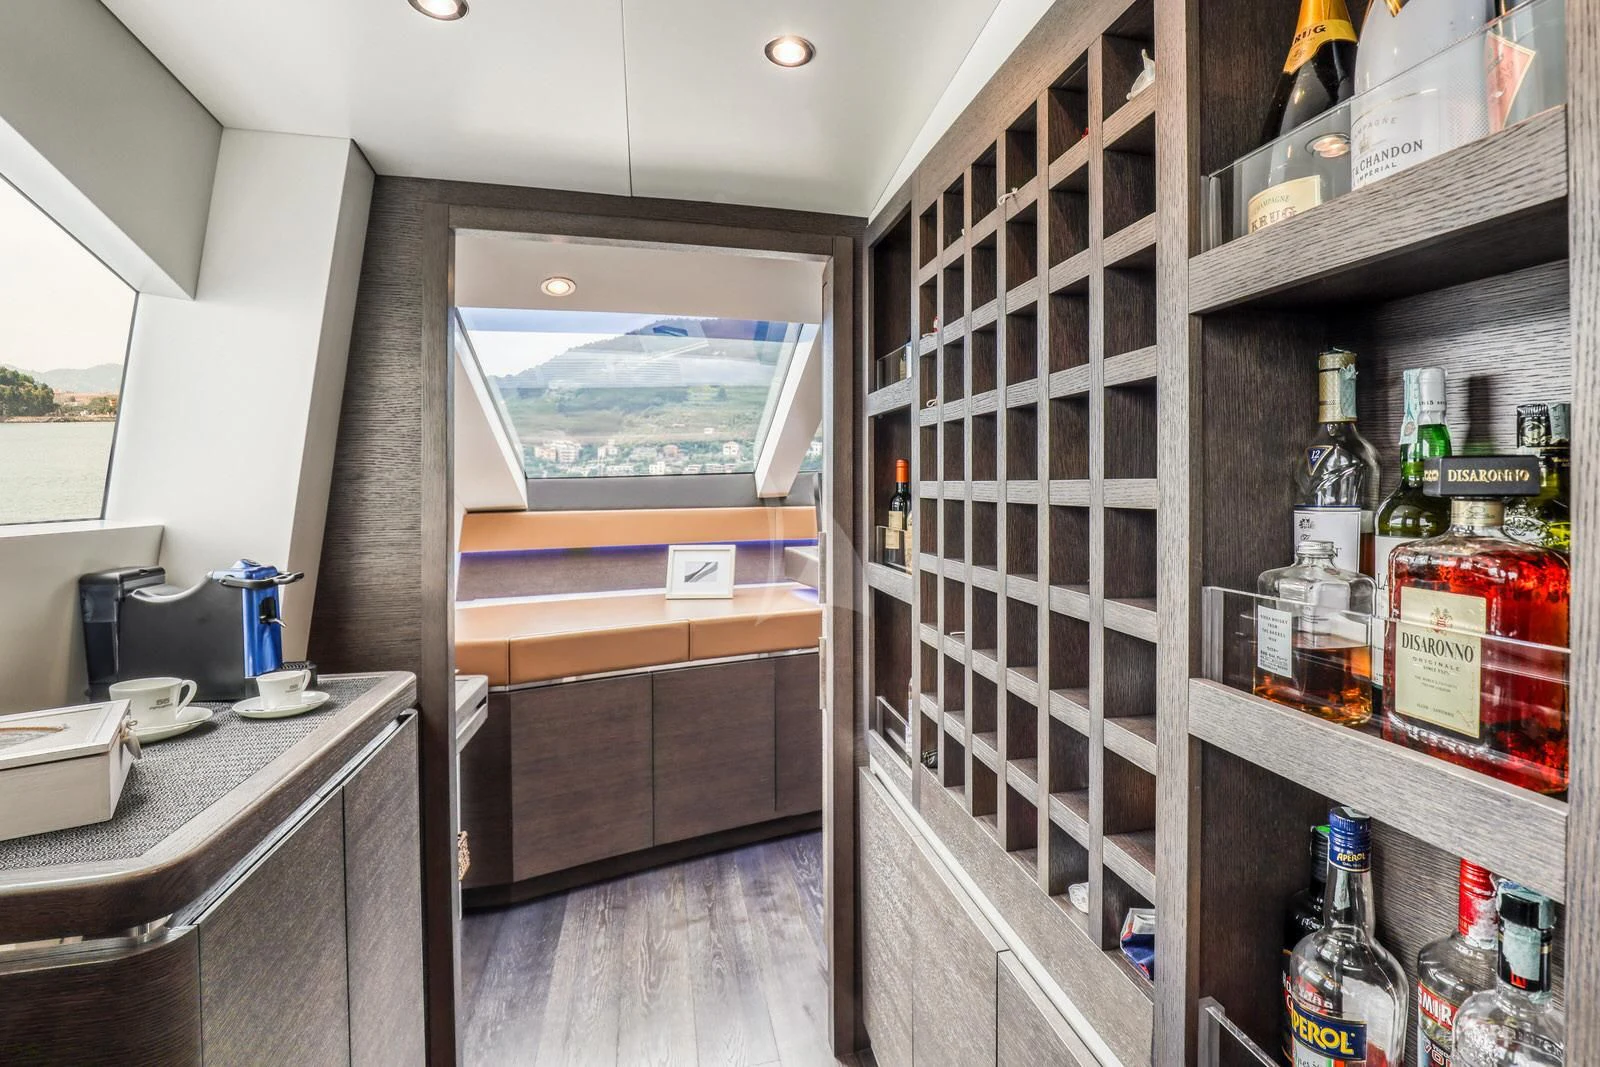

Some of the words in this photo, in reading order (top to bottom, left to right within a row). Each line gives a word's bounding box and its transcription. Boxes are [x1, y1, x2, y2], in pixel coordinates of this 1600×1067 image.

[1294, 25, 1326, 43] RUG
[1360, 139, 1423, 172] CHANDON
[1311, 449, 1321, 459] 12
[1447, 469, 1530, 483] DISARONNO
[1402, 632, 1474, 663] DISARONNO
[1412, 656, 1461, 673] ORIGINALE
[1337, 852, 1365, 862] APEROL
[1418, 986, 1453, 1026] SMIR
